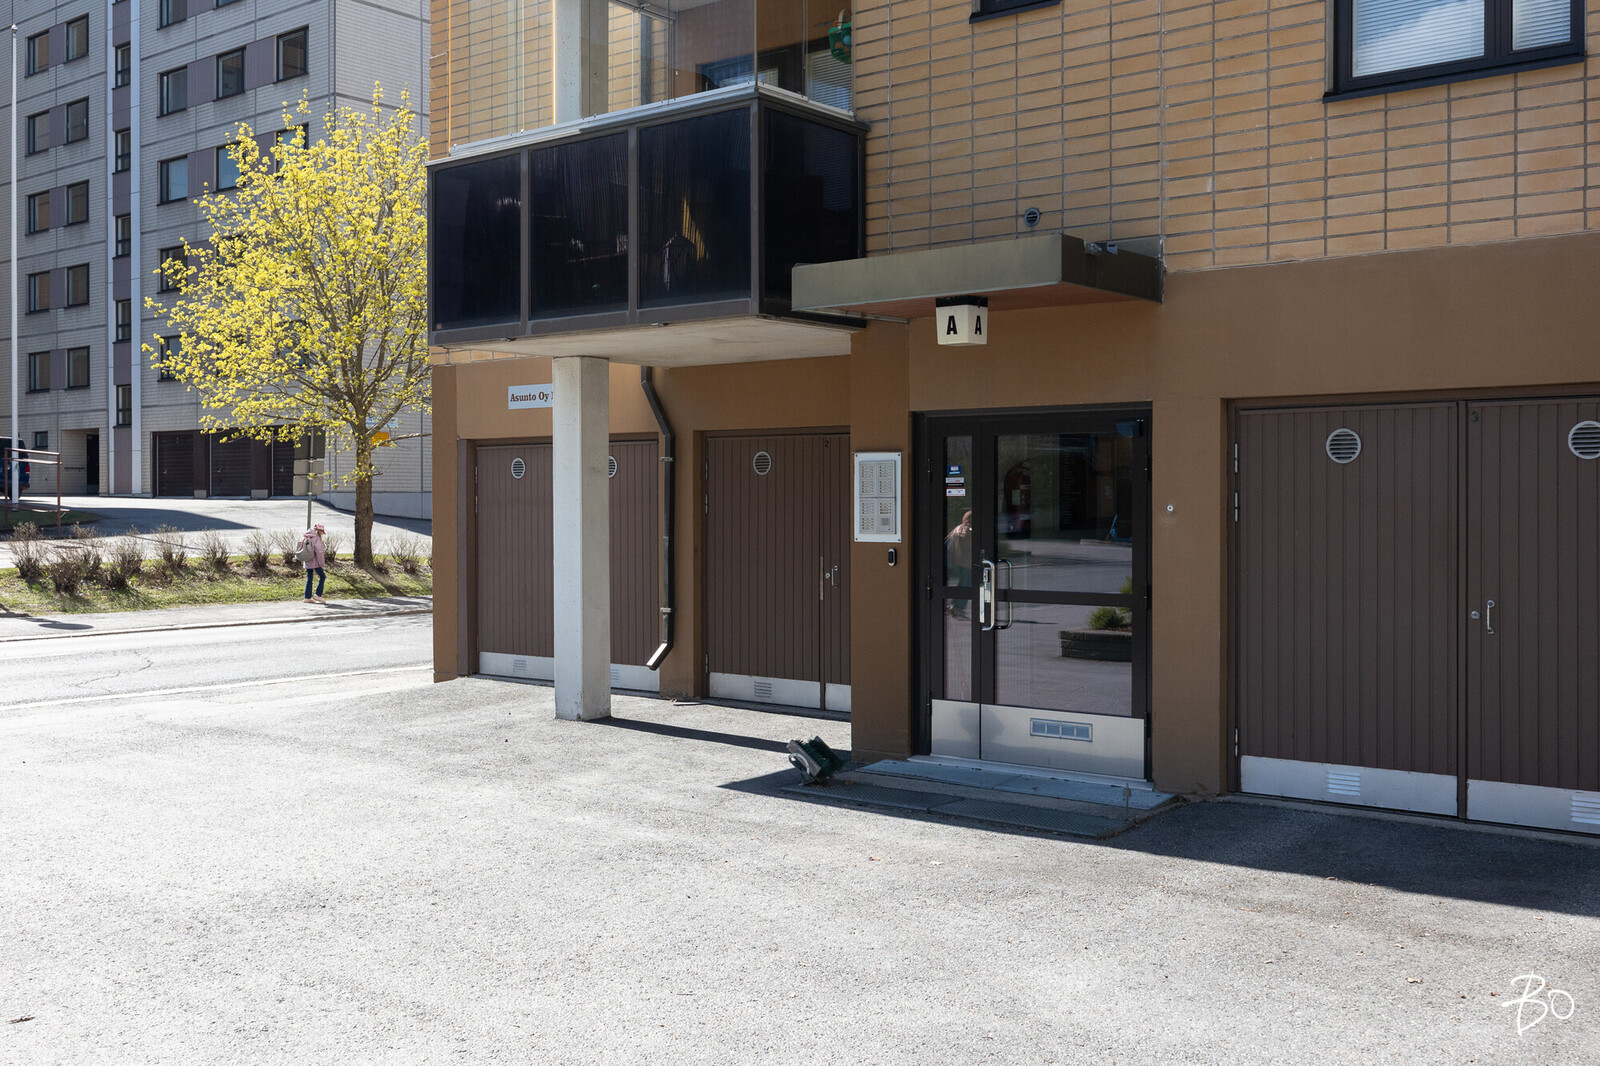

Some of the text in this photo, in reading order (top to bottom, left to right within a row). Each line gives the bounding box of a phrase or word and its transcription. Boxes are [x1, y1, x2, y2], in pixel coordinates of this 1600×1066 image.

[946, 315, 958, 335] A
[974, 315, 982, 335] A
[510, 392, 537, 402] Asunto
[538, 391, 550, 402] Oy
